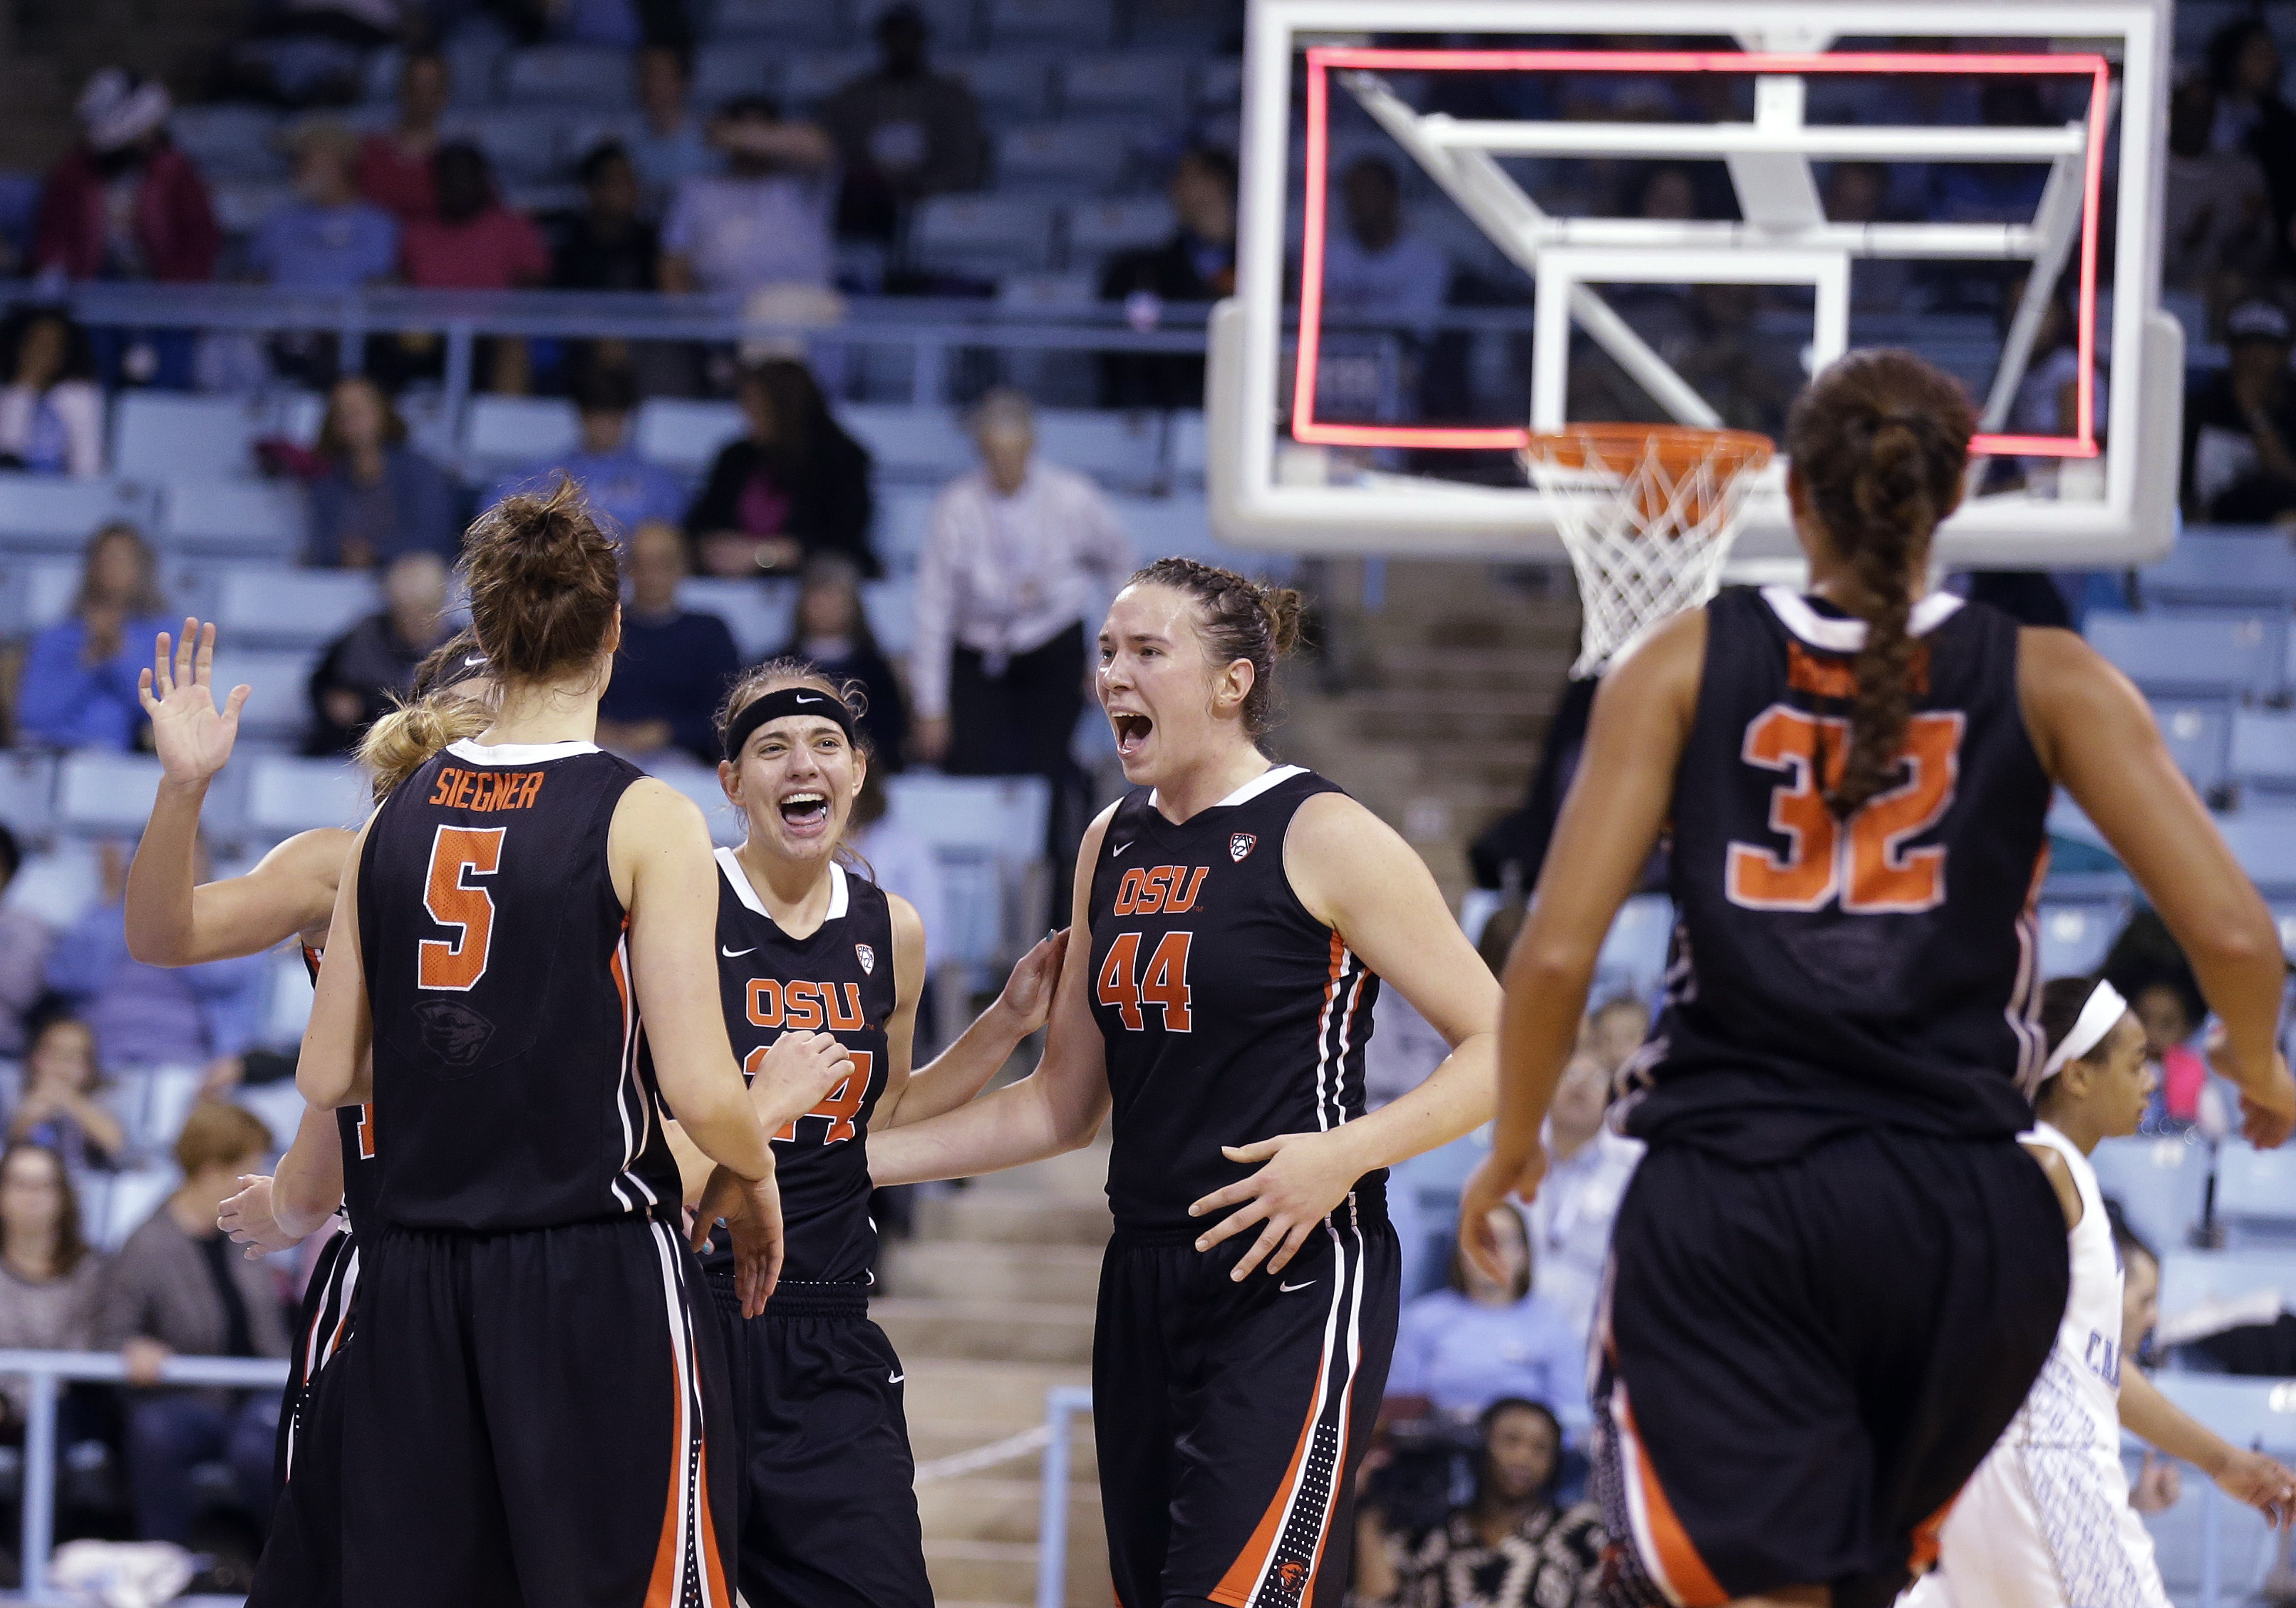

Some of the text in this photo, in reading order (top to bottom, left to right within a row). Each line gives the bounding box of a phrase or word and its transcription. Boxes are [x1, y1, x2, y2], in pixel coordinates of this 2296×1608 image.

[429, 767, 544, 812] SIEGNER
[1724, 703, 1967, 914] 32
[418, 824, 507, 991] 5
[1114, 865, 1209, 916] OSU
[745, 978, 864, 1031] OSU
[1097, 932, 1194, 1033] 44
[743, 1046, 873, 1145] 4
